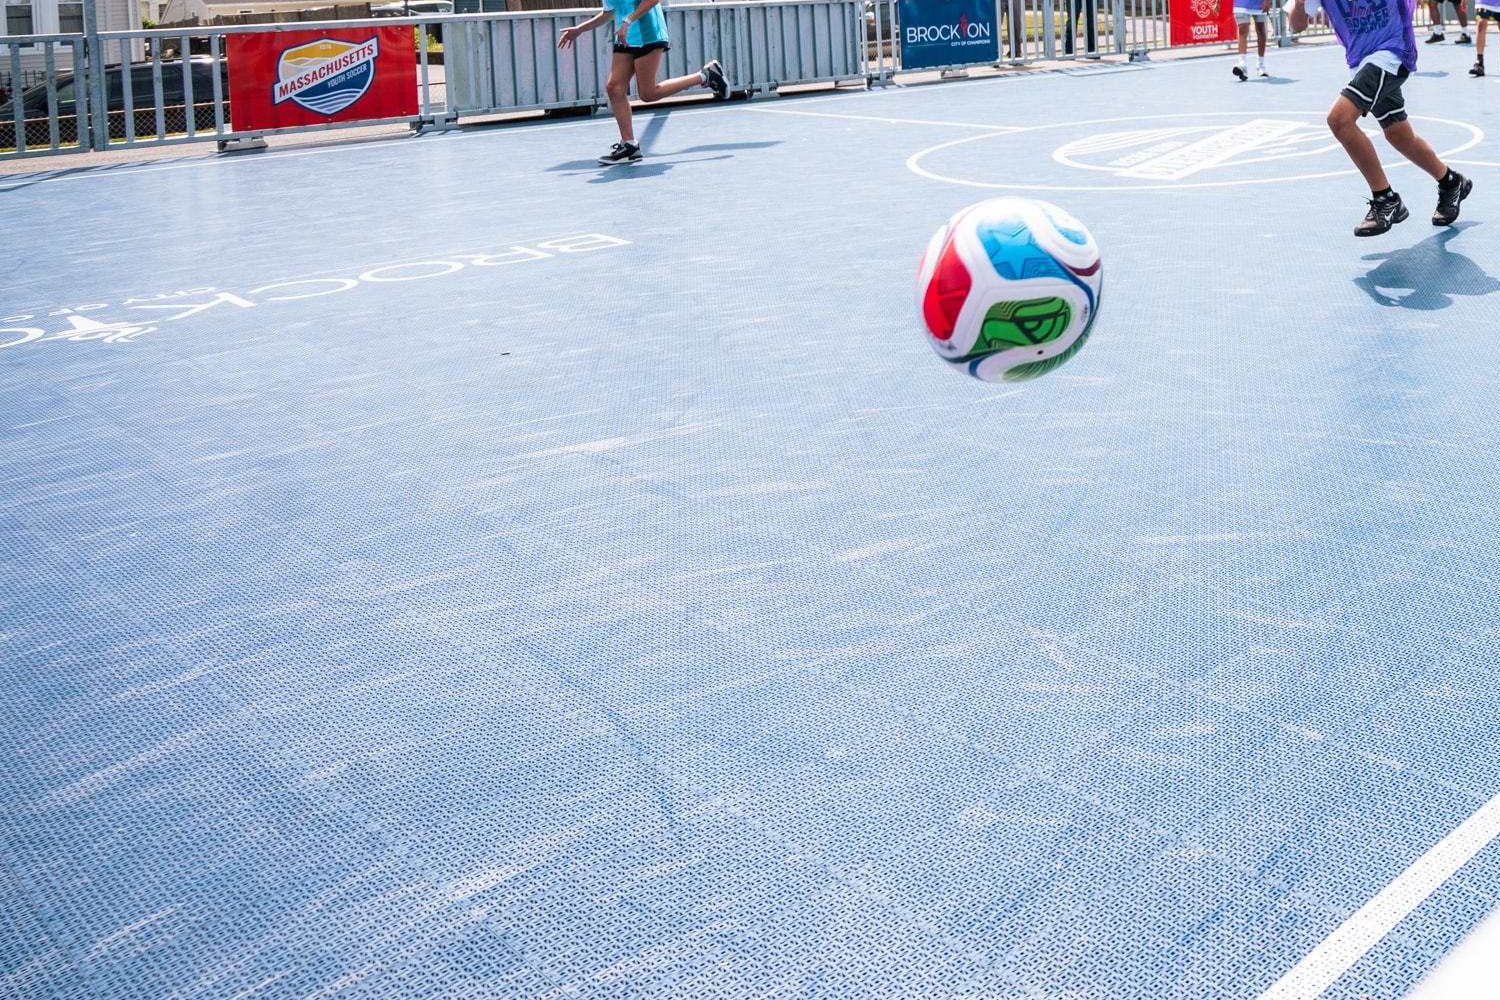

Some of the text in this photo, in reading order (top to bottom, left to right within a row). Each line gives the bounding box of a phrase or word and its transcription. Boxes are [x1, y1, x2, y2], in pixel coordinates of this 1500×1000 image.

[1344, 8, 1390, 29] SOCCER
[1191, 25, 1219, 35] YOUTH
[279, 44, 374, 98] MASSACHUSETTS
[327, 64, 367, 88] YOUTH SOCCER
